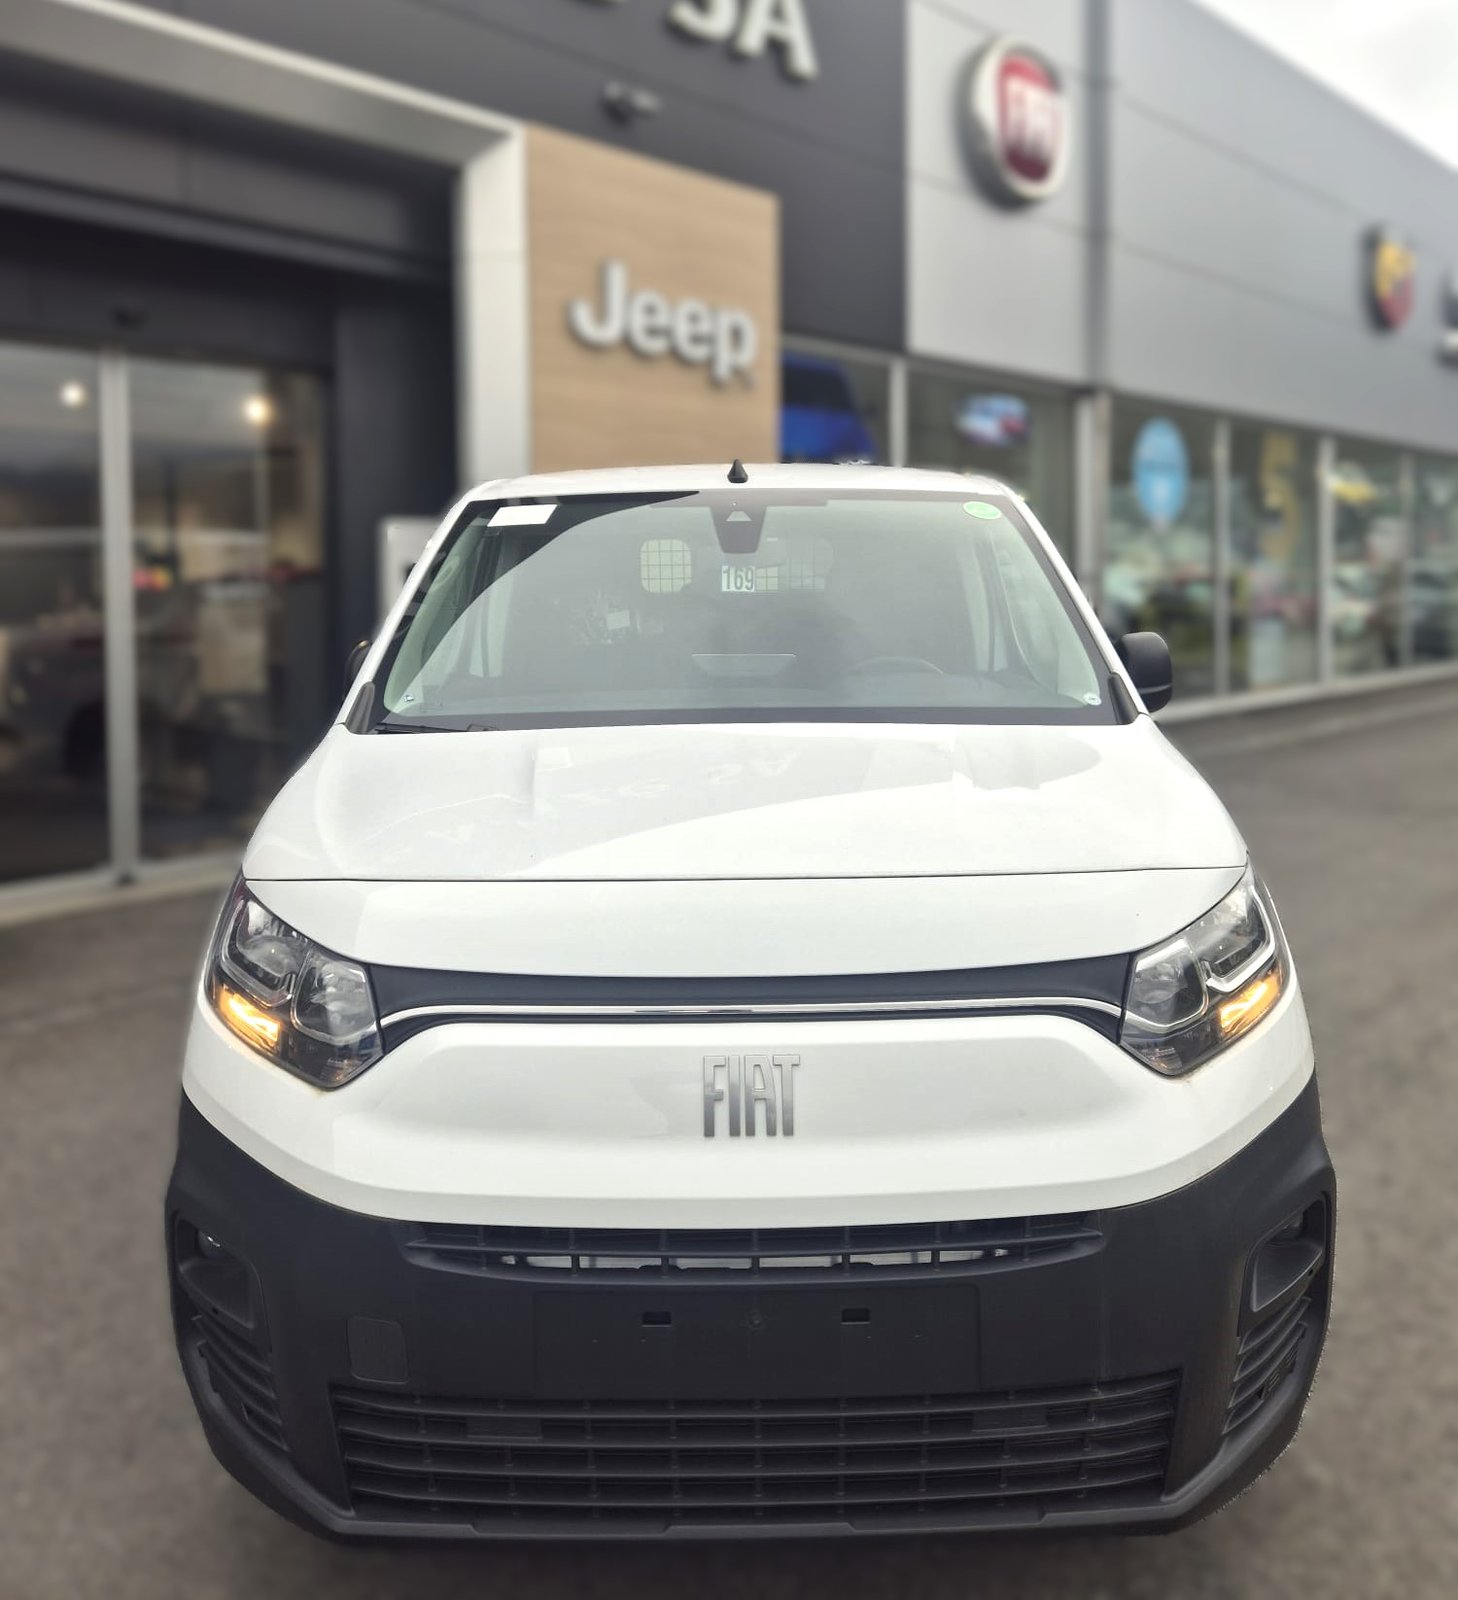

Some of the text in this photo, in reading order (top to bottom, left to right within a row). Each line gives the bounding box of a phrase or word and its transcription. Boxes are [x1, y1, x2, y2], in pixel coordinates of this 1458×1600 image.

[568, 259, 757, 383] Jeep
[722, 567, 753, 590] 169
[703, 1055, 800, 1137] FIAT
